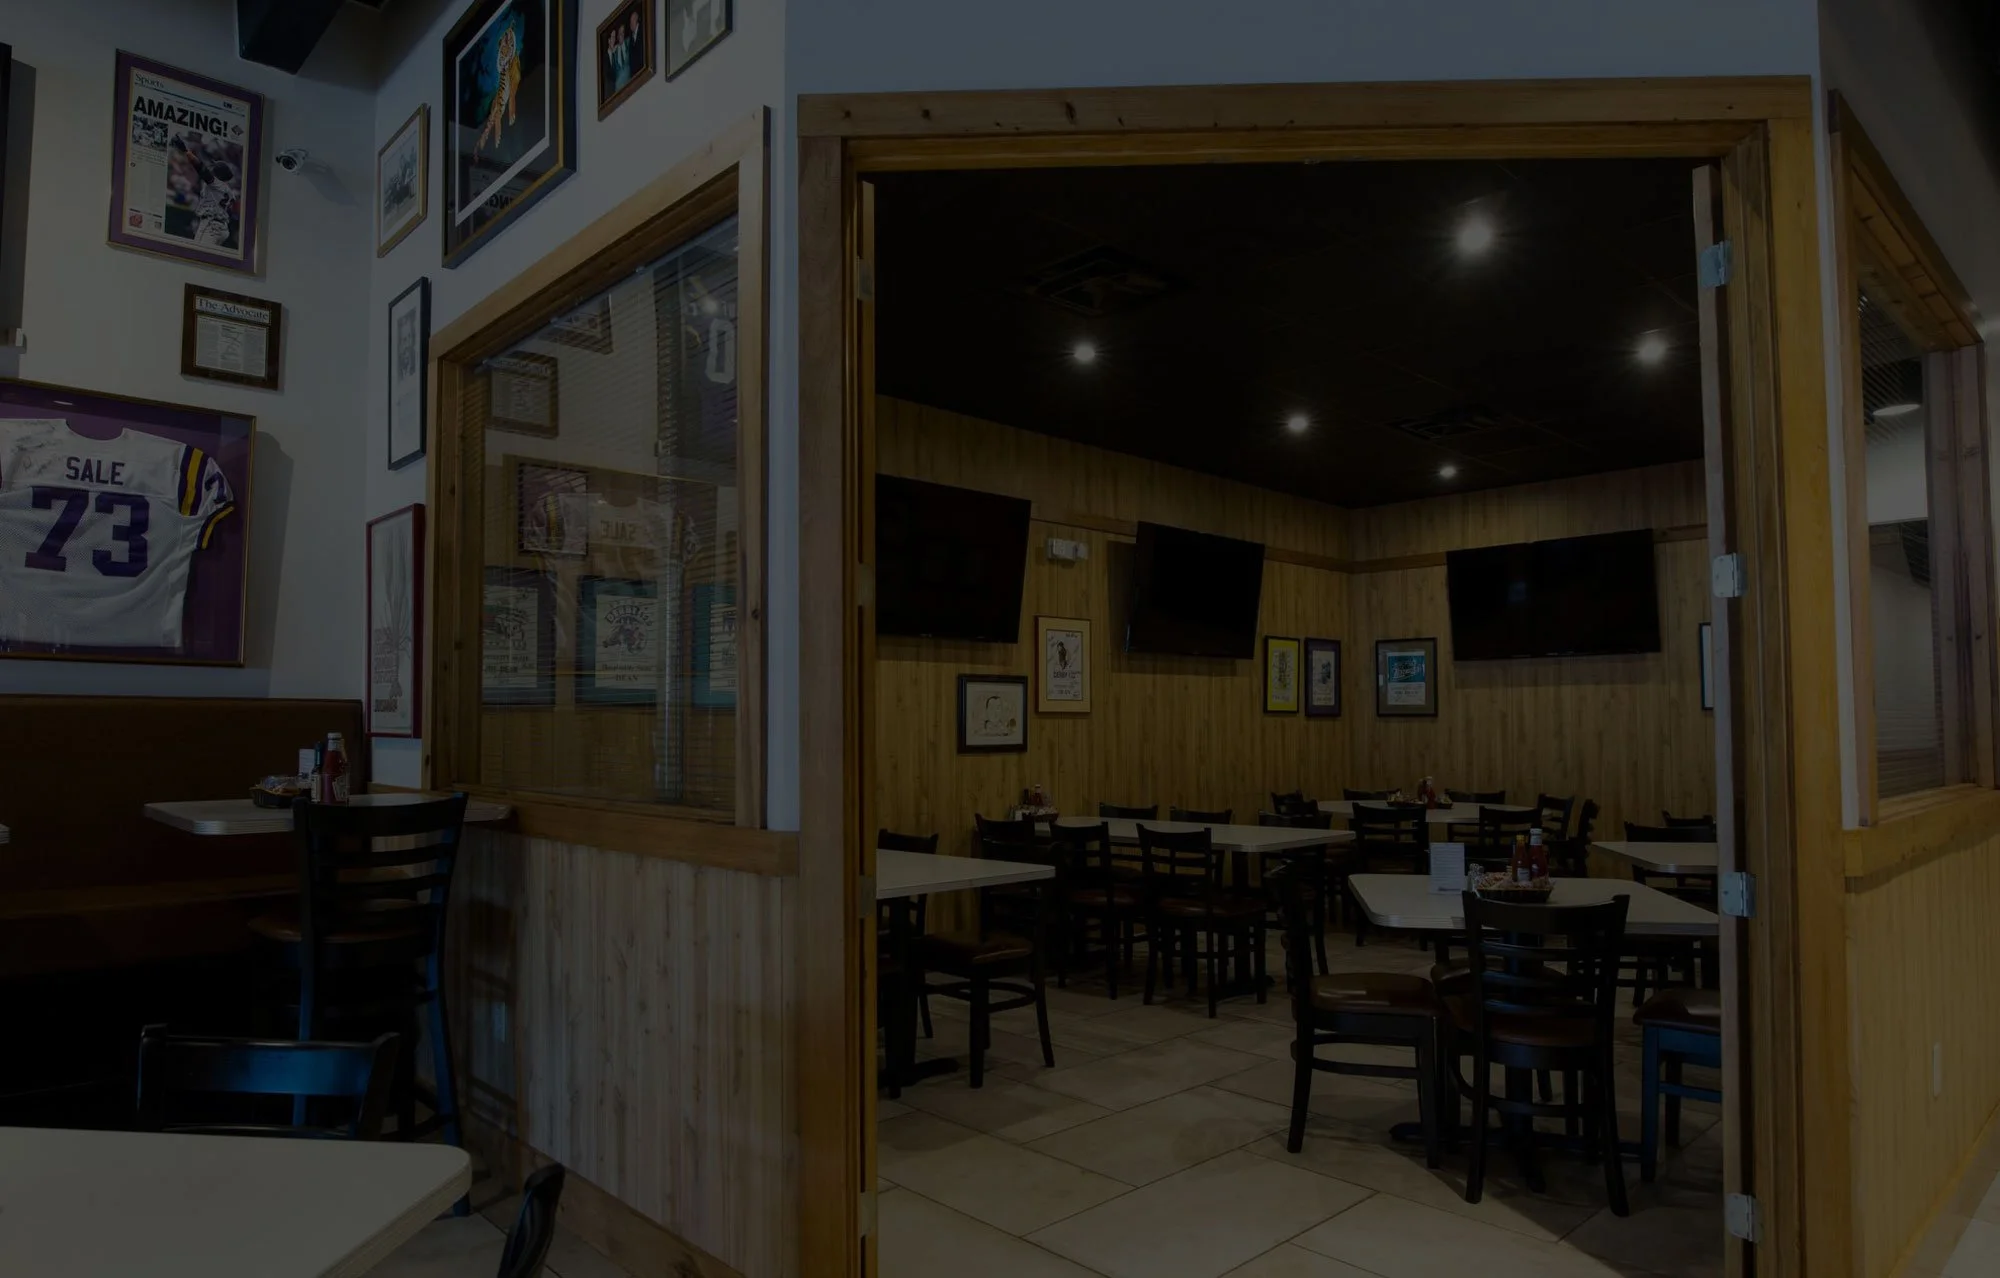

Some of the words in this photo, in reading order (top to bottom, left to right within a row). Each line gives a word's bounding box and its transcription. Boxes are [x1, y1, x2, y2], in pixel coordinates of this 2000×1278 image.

[135, 73, 164, 88] Sports
[134, 96, 228, 137] AMAZING!
[199, 299, 218, 310] The
[221, 303, 269, 320] Advocate
[65, 456, 125, 486] SALE
[25, 486, 150, 577] 73
